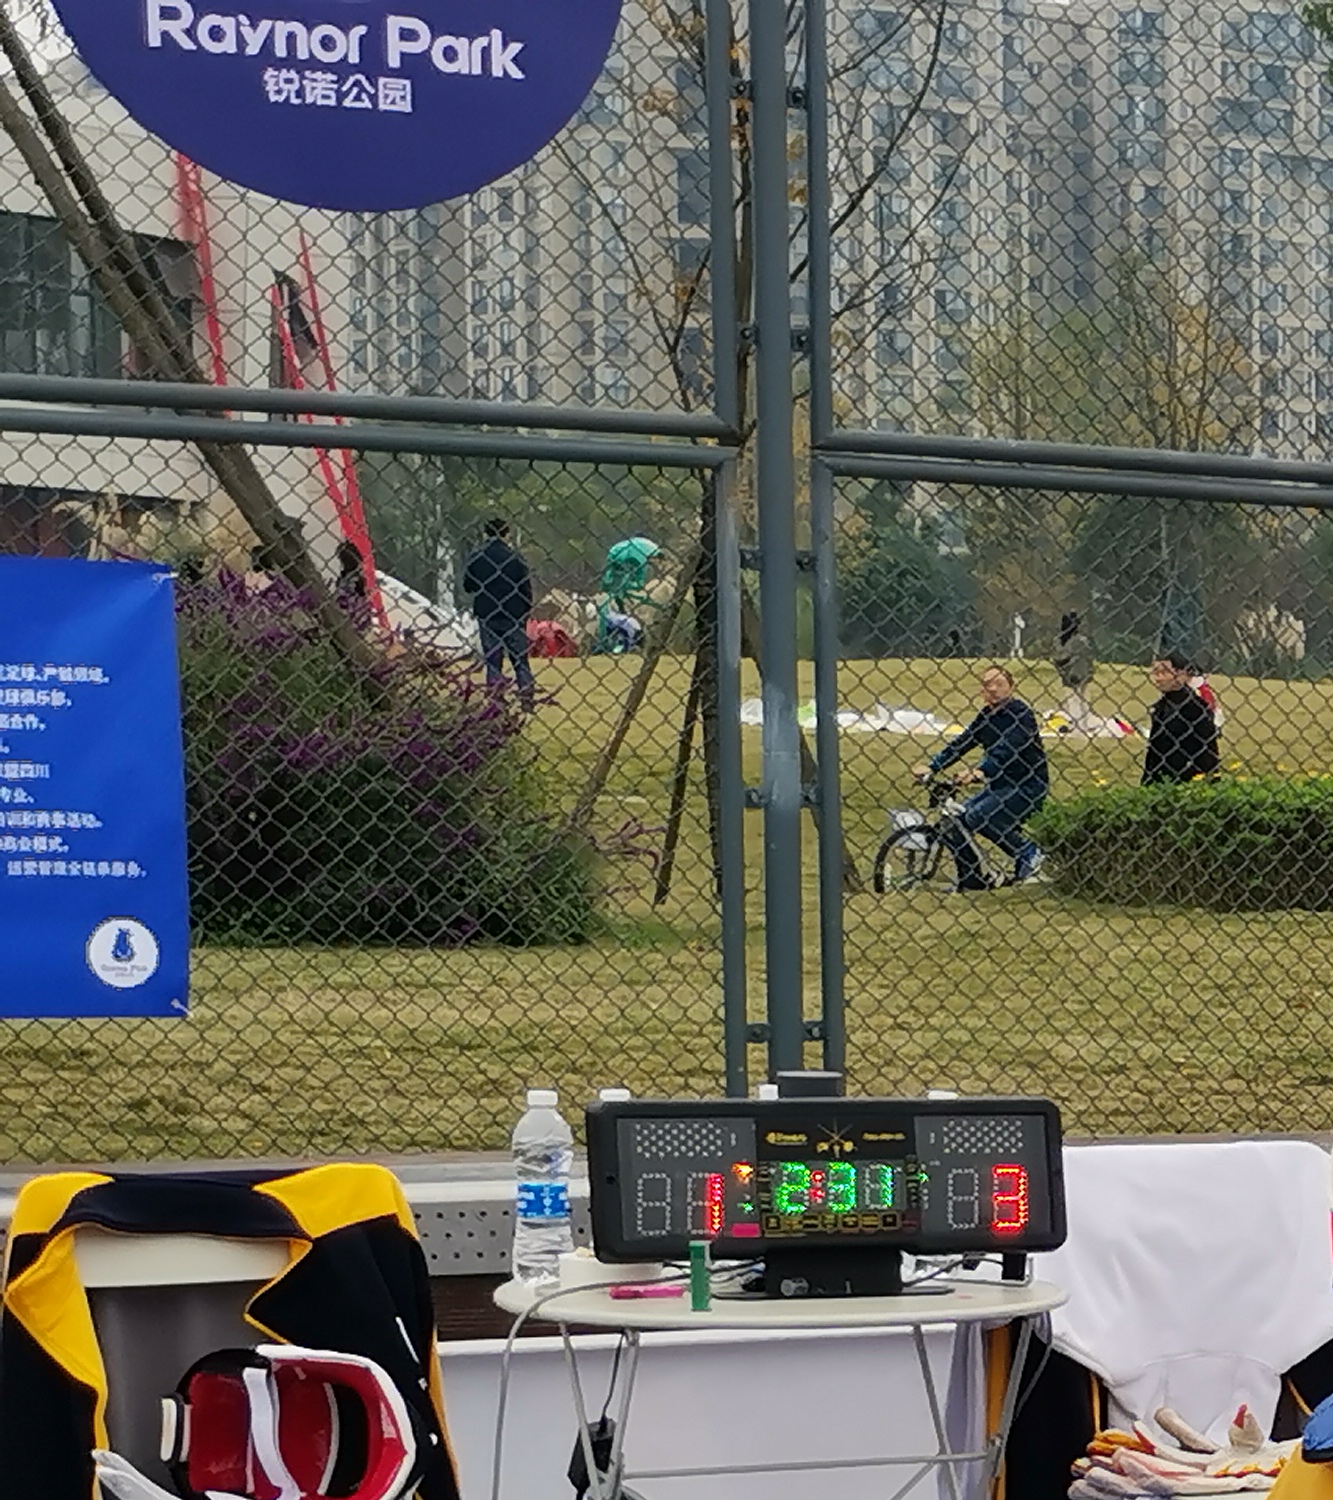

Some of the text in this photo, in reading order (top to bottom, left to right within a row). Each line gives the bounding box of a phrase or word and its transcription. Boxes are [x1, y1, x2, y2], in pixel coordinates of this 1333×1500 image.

[146, 0, 527, 81] Raynor Park
[263, 68, 413, 114] 锐诺公园
[775, 1161, 894, 1214] 2:31
[990, 1163, 1029, 1231] 3
